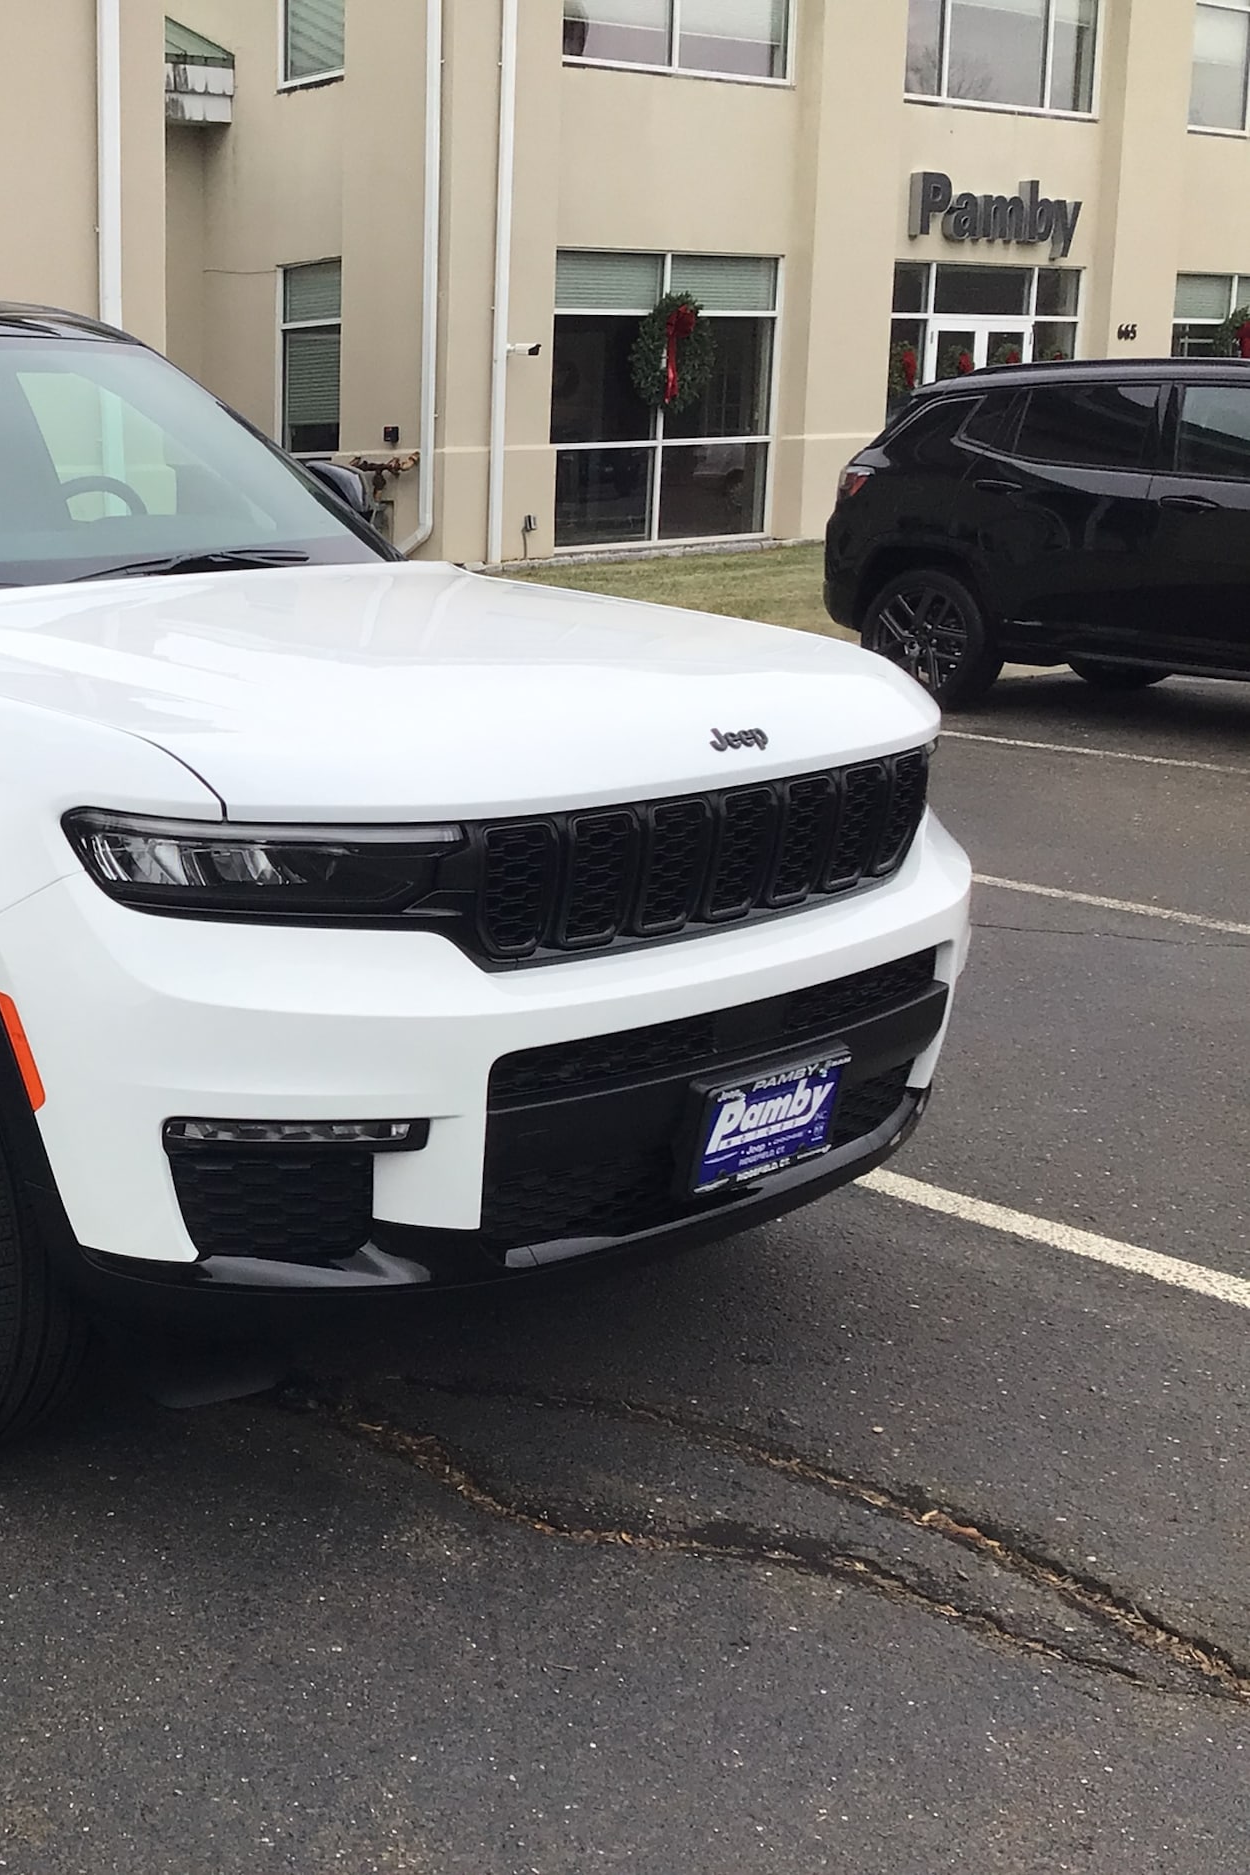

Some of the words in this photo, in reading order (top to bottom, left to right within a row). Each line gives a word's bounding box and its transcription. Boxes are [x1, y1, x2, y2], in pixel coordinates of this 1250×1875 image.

[908, 172, 1082, 260] Pamby
[1117, 324, 1137, 340] 665
[710, 728, 768, 751] Jeep
[752, 1063, 819, 1092] PAMBY
[705, 1078, 835, 1155] Pamby
